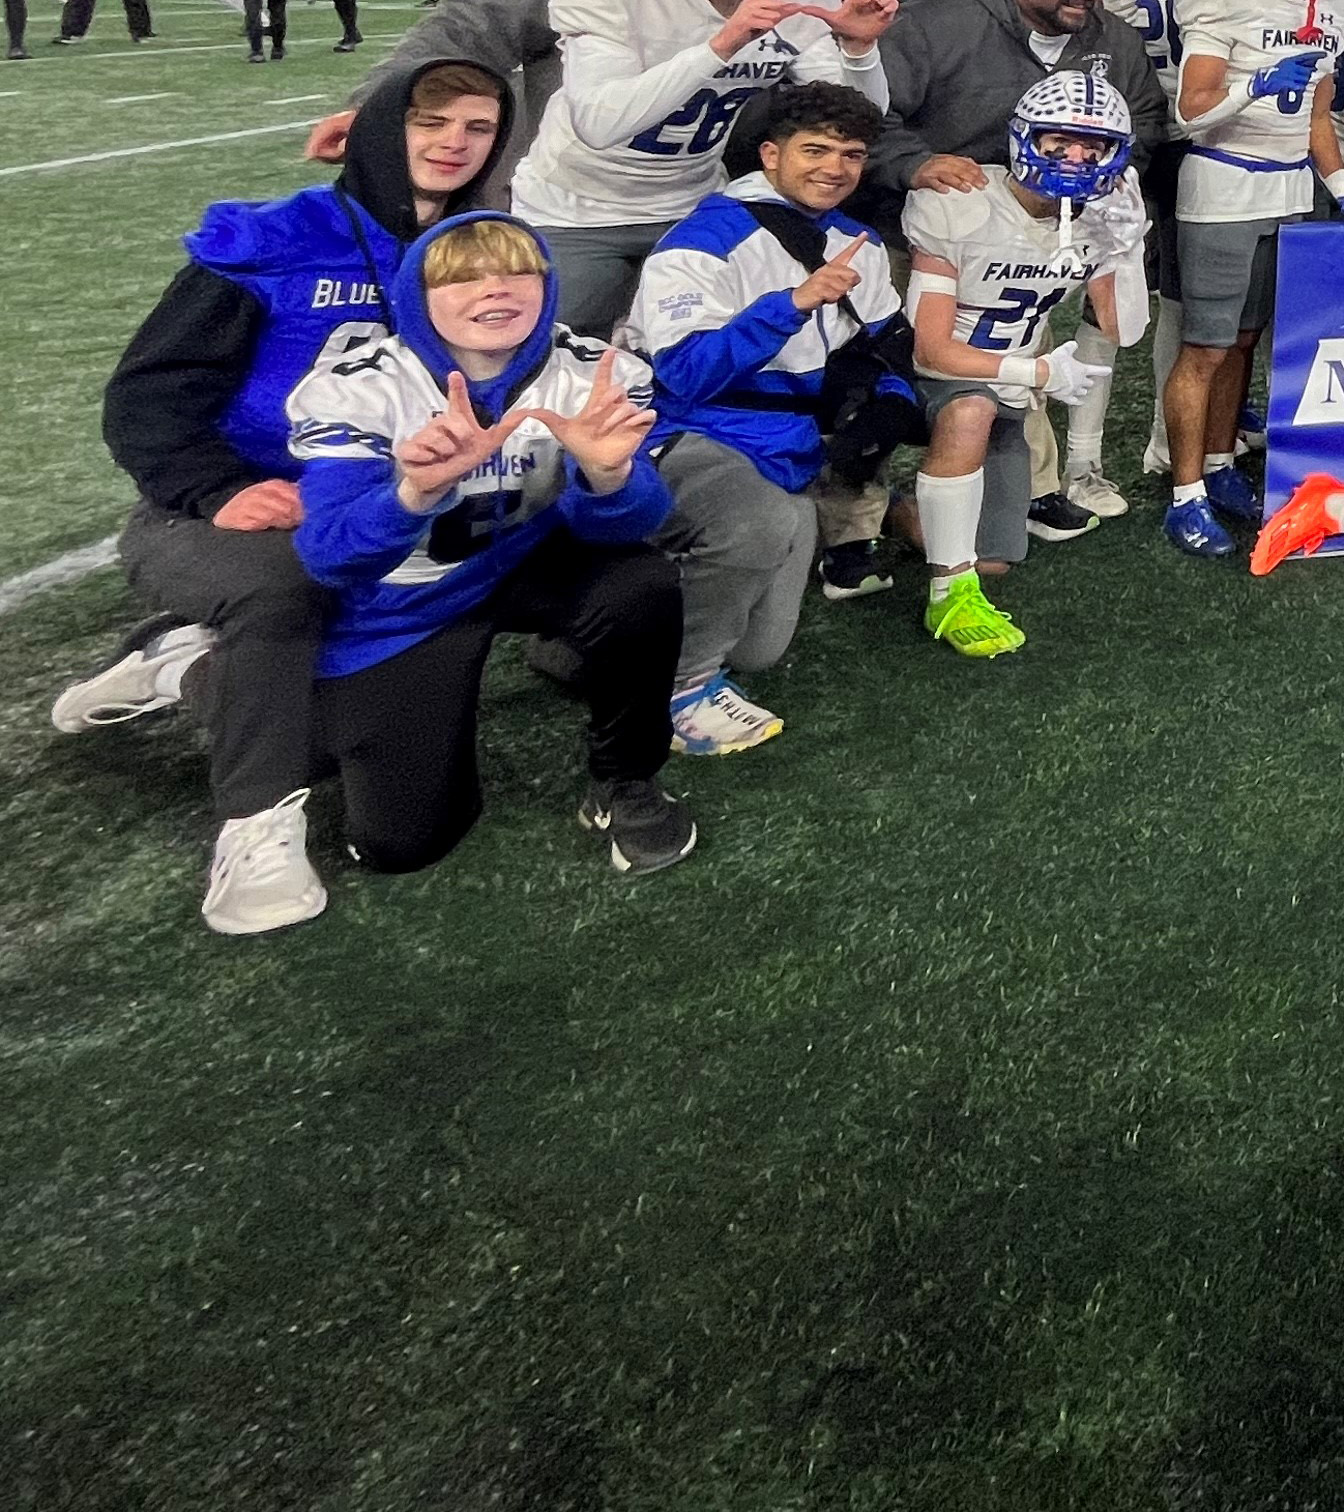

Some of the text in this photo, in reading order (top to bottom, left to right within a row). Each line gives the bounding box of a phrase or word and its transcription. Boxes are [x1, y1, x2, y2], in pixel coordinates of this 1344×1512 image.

[1263, 29, 1339, 53] FAIRAVEN
[982, 261, 1099, 282] FAIRHAVEN
[311, 279, 384, 309] BLUE
[967, 287, 1067, 350] 21
